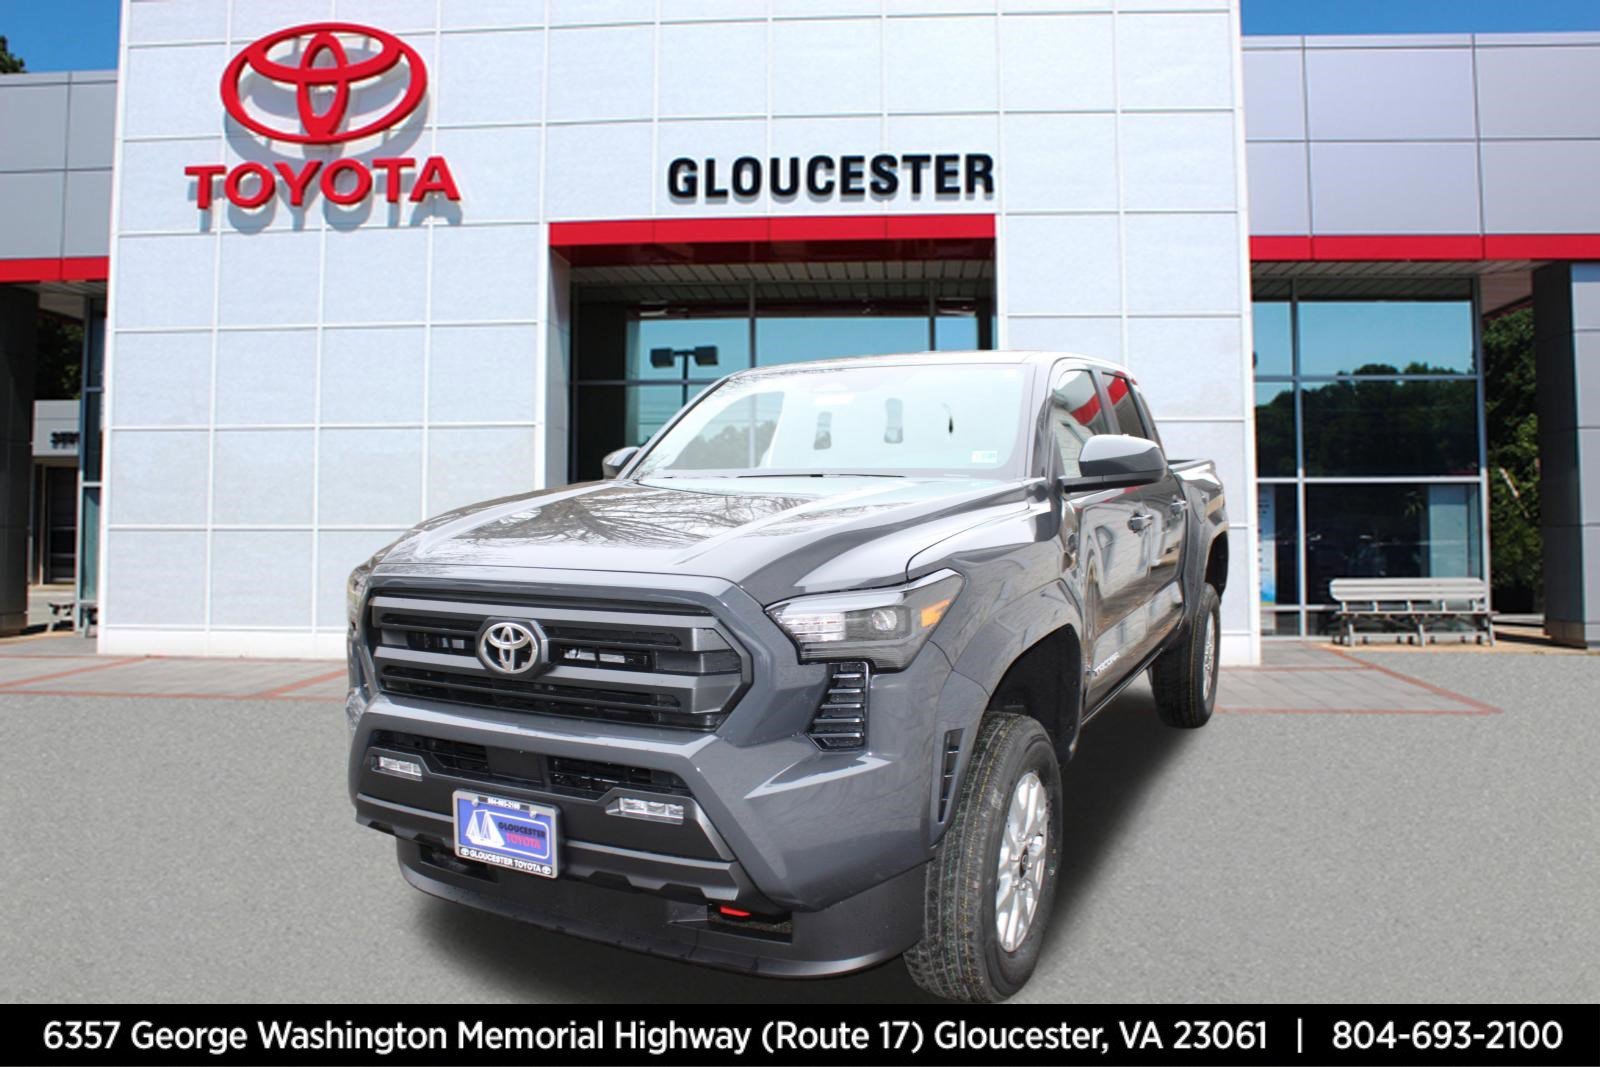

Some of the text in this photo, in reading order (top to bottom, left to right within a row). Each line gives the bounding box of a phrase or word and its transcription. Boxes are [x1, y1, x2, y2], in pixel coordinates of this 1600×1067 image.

[184, 155, 461, 210] TOYOTA
[668, 153, 995, 198] GLOUCESTER
[498, 821, 546, 837] GLOUCESTER
[506, 832, 541, 849] TOYOTA
[470, 849, 541, 873] GLOUCESTER TOYOTA
